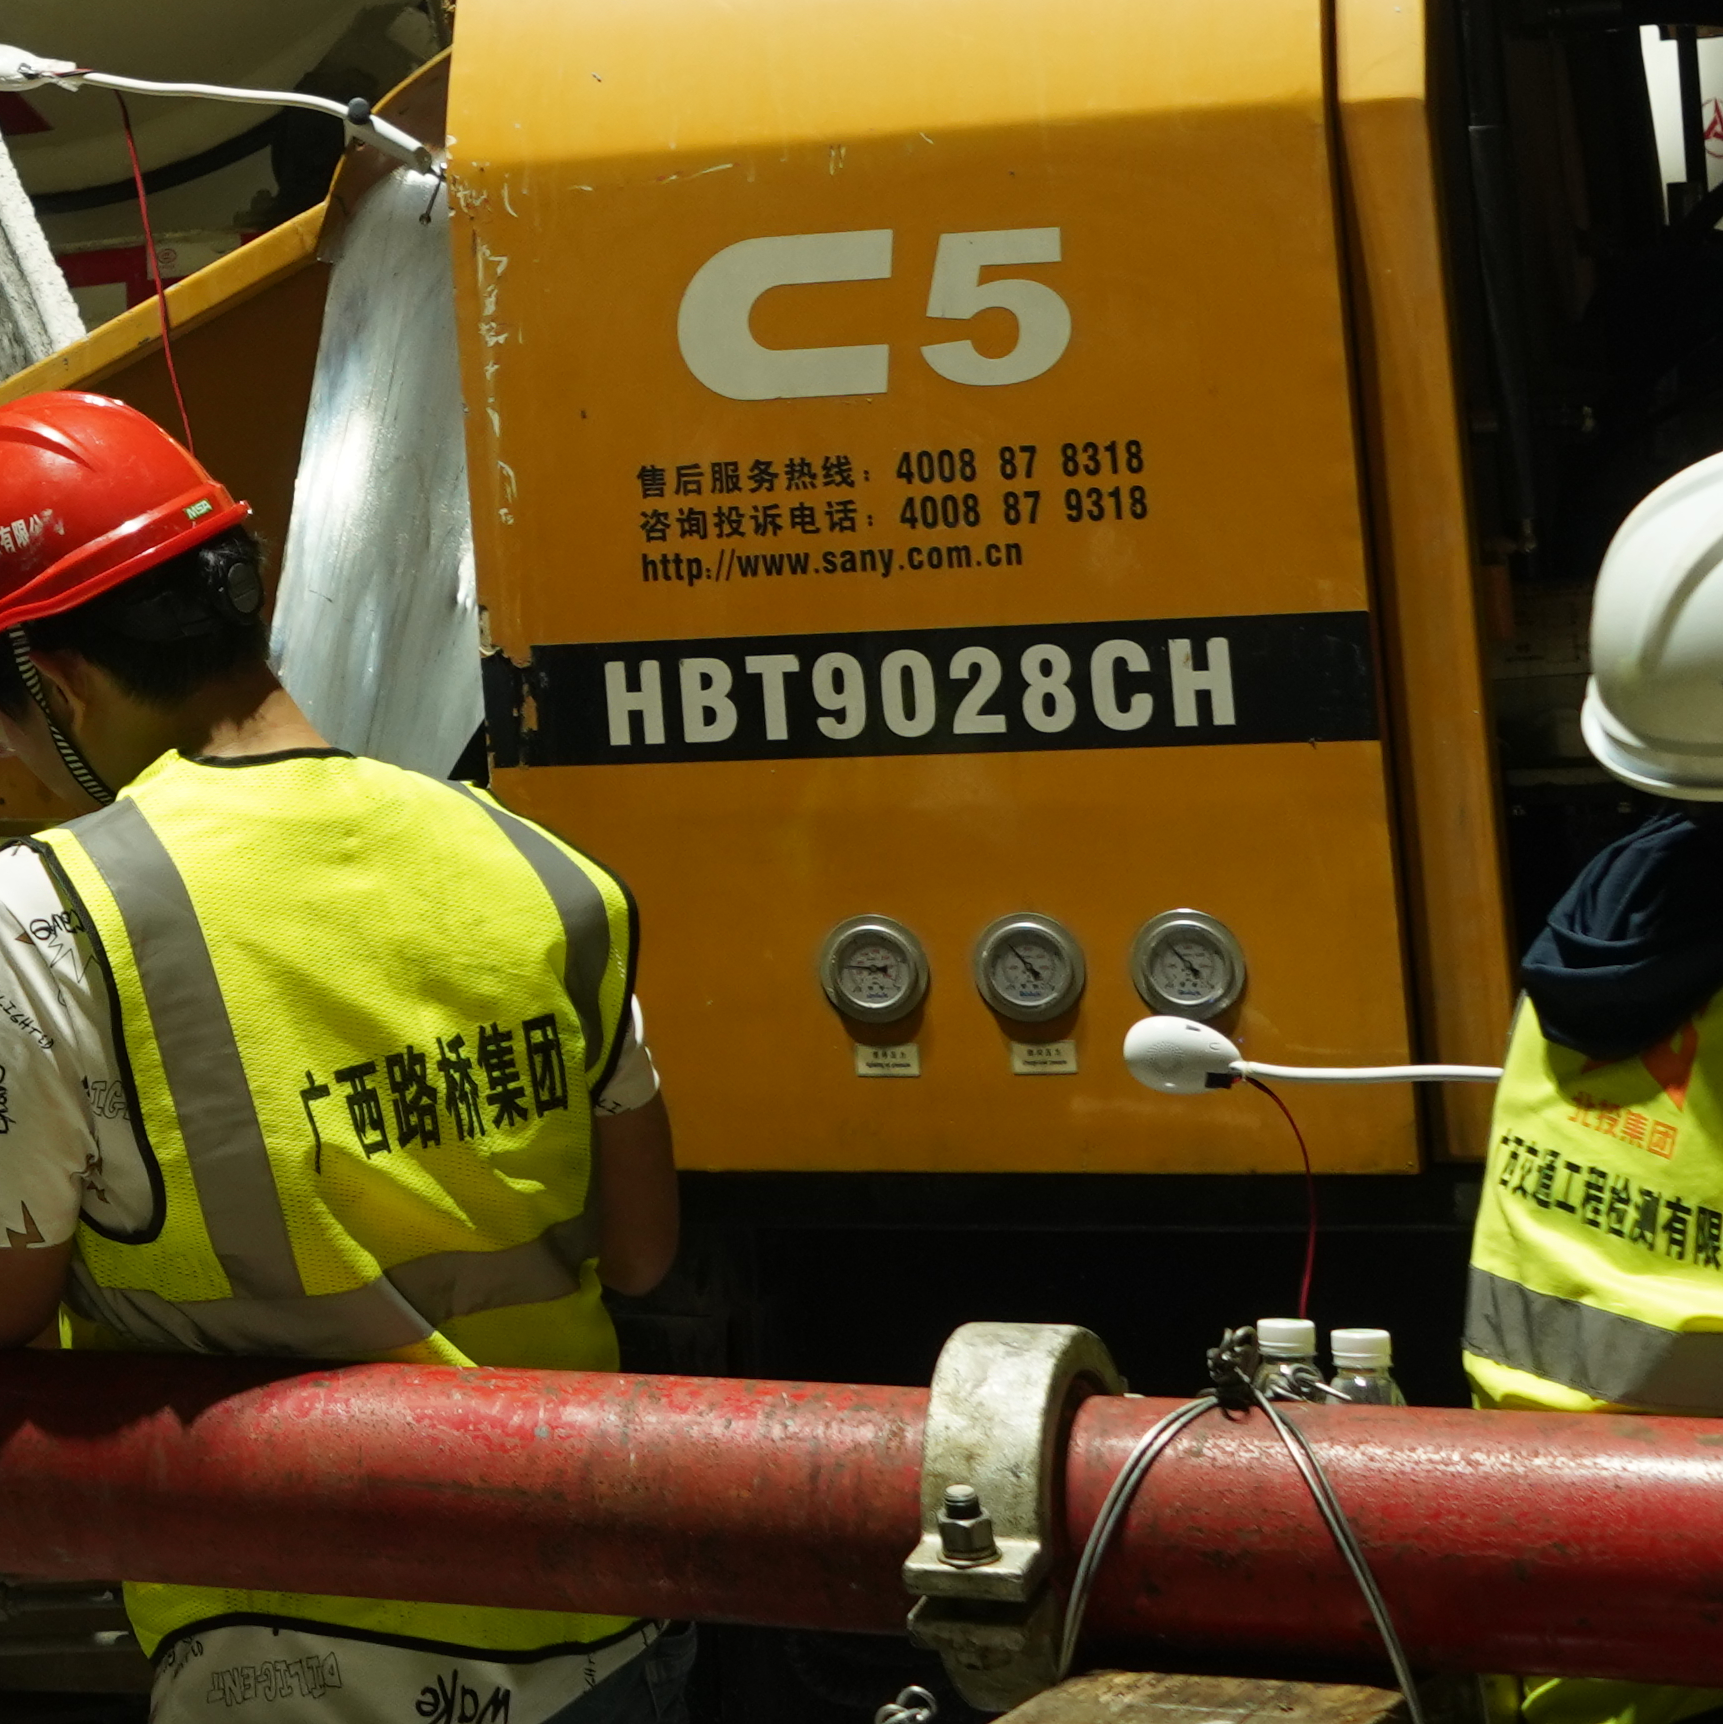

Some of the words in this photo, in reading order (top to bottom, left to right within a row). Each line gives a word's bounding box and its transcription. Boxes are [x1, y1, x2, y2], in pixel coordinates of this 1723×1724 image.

[676, 226, 1073, 402] C5
[896, 448, 977, 485] 4008
[999, 444, 1038, 480] 87
[1061, 439, 1144, 477] 8318
[186, 502, 212, 518] MSA
[899, 493, 981, 530] 4008
[1003, 490, 1042, 525] 87
[1064, 484, 1149, 523] 9318
[640, 541, 1024, 587] http://www.sany.com.cn
[604, 636, 1238, 747] HBT9028CH
[298, 1013, 570, 1175] 广西路桥集团
[1567, 1091, 1679, 1161] 北投集团
[206, 1651, 343, 1707] DILIGENT
